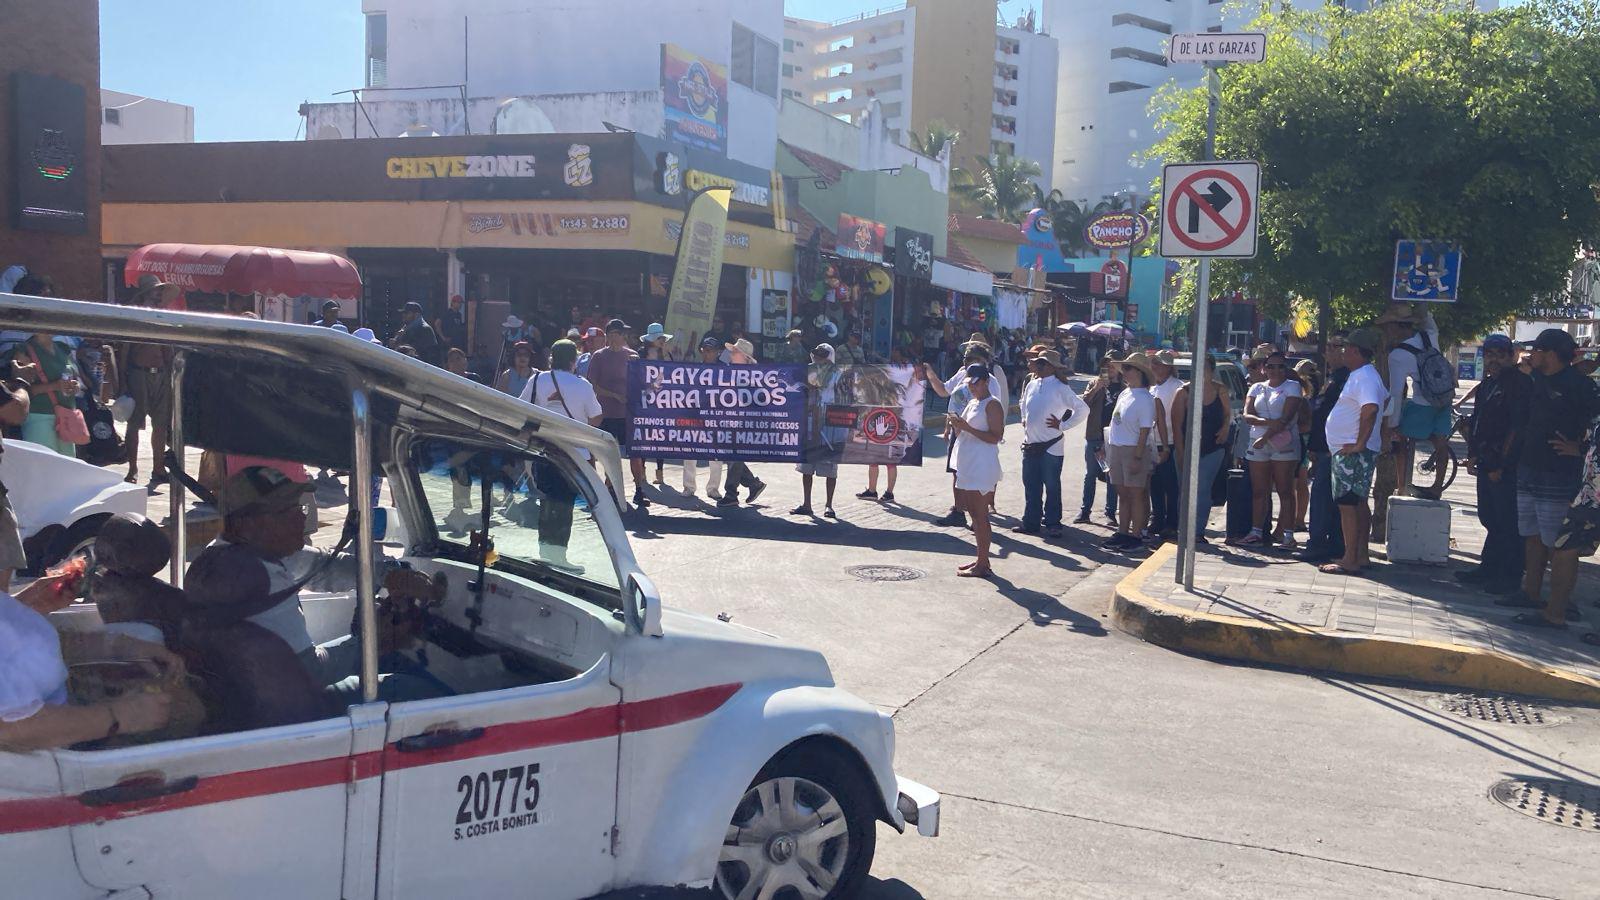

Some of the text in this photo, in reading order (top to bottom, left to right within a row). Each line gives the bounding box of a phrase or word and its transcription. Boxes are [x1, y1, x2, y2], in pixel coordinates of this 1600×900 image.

[1180, 42, 1256, 54] DE LAS GARZAS
[386, 155, 536, 179] CHEVEZONE
[138, 260, 225, 276] HOT DOGS Y HAMBURGUESAS
[164, 272, 195, 287] ERIKA
[645, 365, 779, 388] PLAYA LIBRE
[641, 387, 787, 409] PARA TODOS
[633, 417, 664, 426] ESTAMOS
[665, 418, 675, 426] EN
[720, 420, 743, 428] CIERRE
[745, 421, 754, 429] DE
[756, 421, 769, 429] LOS
[770, 421, 799, 430] ACCESOS
[633, 428, 799, 446] A LAS PLAYAS DE MAZATLAN
[455, 763, 540, 824] 20775
[454, 827, 463, 840] S.
[467, 820, 499, 838] COSTA
[502, 812, 539, 830] BONITA
